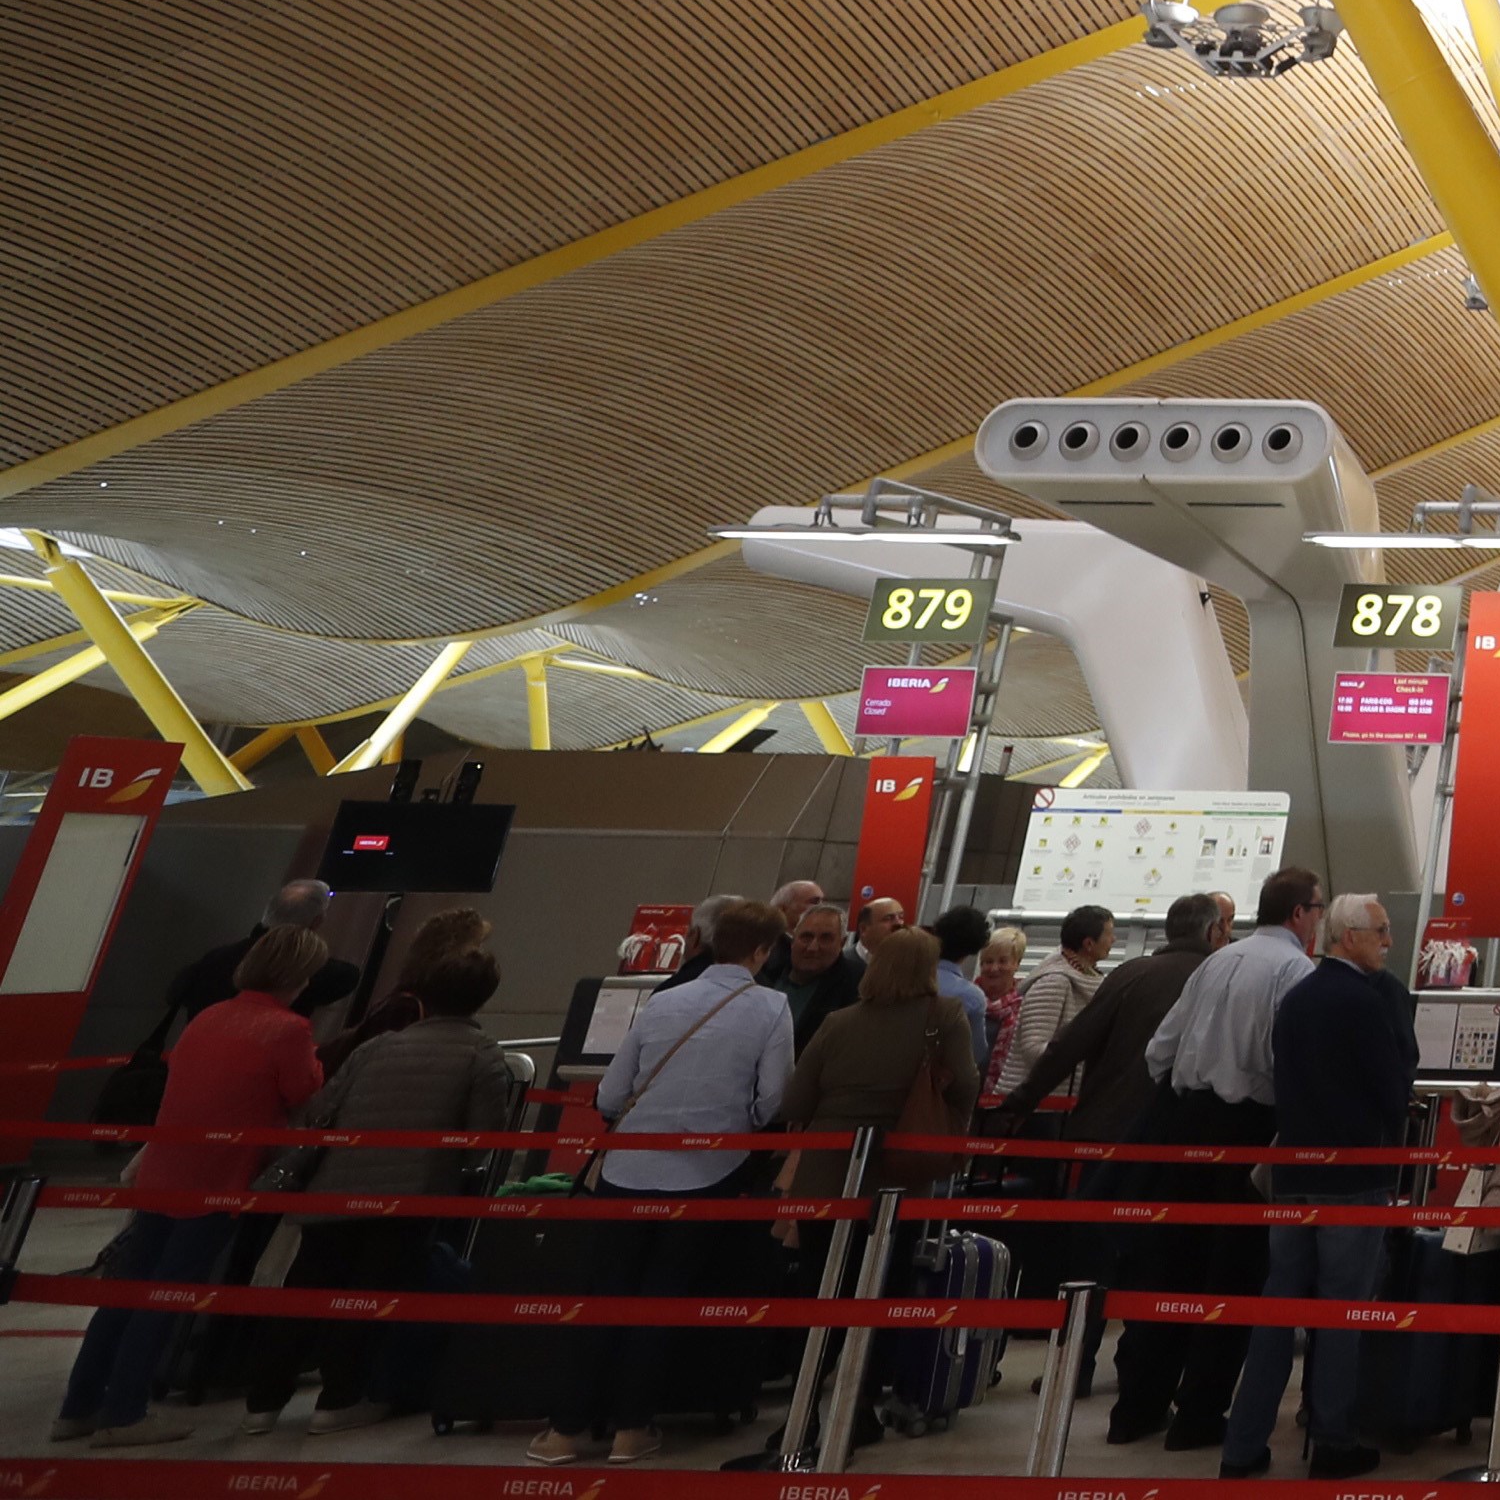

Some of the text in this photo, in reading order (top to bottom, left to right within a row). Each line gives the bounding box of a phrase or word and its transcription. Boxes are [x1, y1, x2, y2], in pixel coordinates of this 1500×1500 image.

[883, 588, 972, 629] 879
[1353, 594, 1445, 636] 878
[1475, 636, 1495, 649] IB
[887, 678, 931, 688] IBERIA
[865, 698, 892, 707] Cerrado
[863, 707, 886, 716] Closed
[79, 768, 113, 787] IB
[876, 780, 895, 792] IB
[63, 1192, 101, 1202] IBERIA
[204, 1196, 241, 1206] IBERIA
[346, 1200, 384, 1210] IBERIA
[488, 1203, 526, 1213] IBERIA
[1112, 1207, 1152, 1217] IBERIA
[1263, 1209, 1302, 1219] IBERIA
[1412, 1211, 1452, 1221] IBERIA
[149, 1290, 196, 1303] IBERIA
[330, 1298, 378, 1310] IBERIA
[514, 1303, 562, 1315] IBERIA
[1155, 1301, 1204, 1314] IBERIA
[699, 1305, 748, 1317] IBERIA
[887, 1306, 936, 1318] IBERIA
[1346, 1309, 1396, 1322] IBERIA
[228, 1475, 298, 1490] IBERIA
[503, 1480, 573, 1496] IBERIA
[779, 1486, 850, 1500] IBERIA
